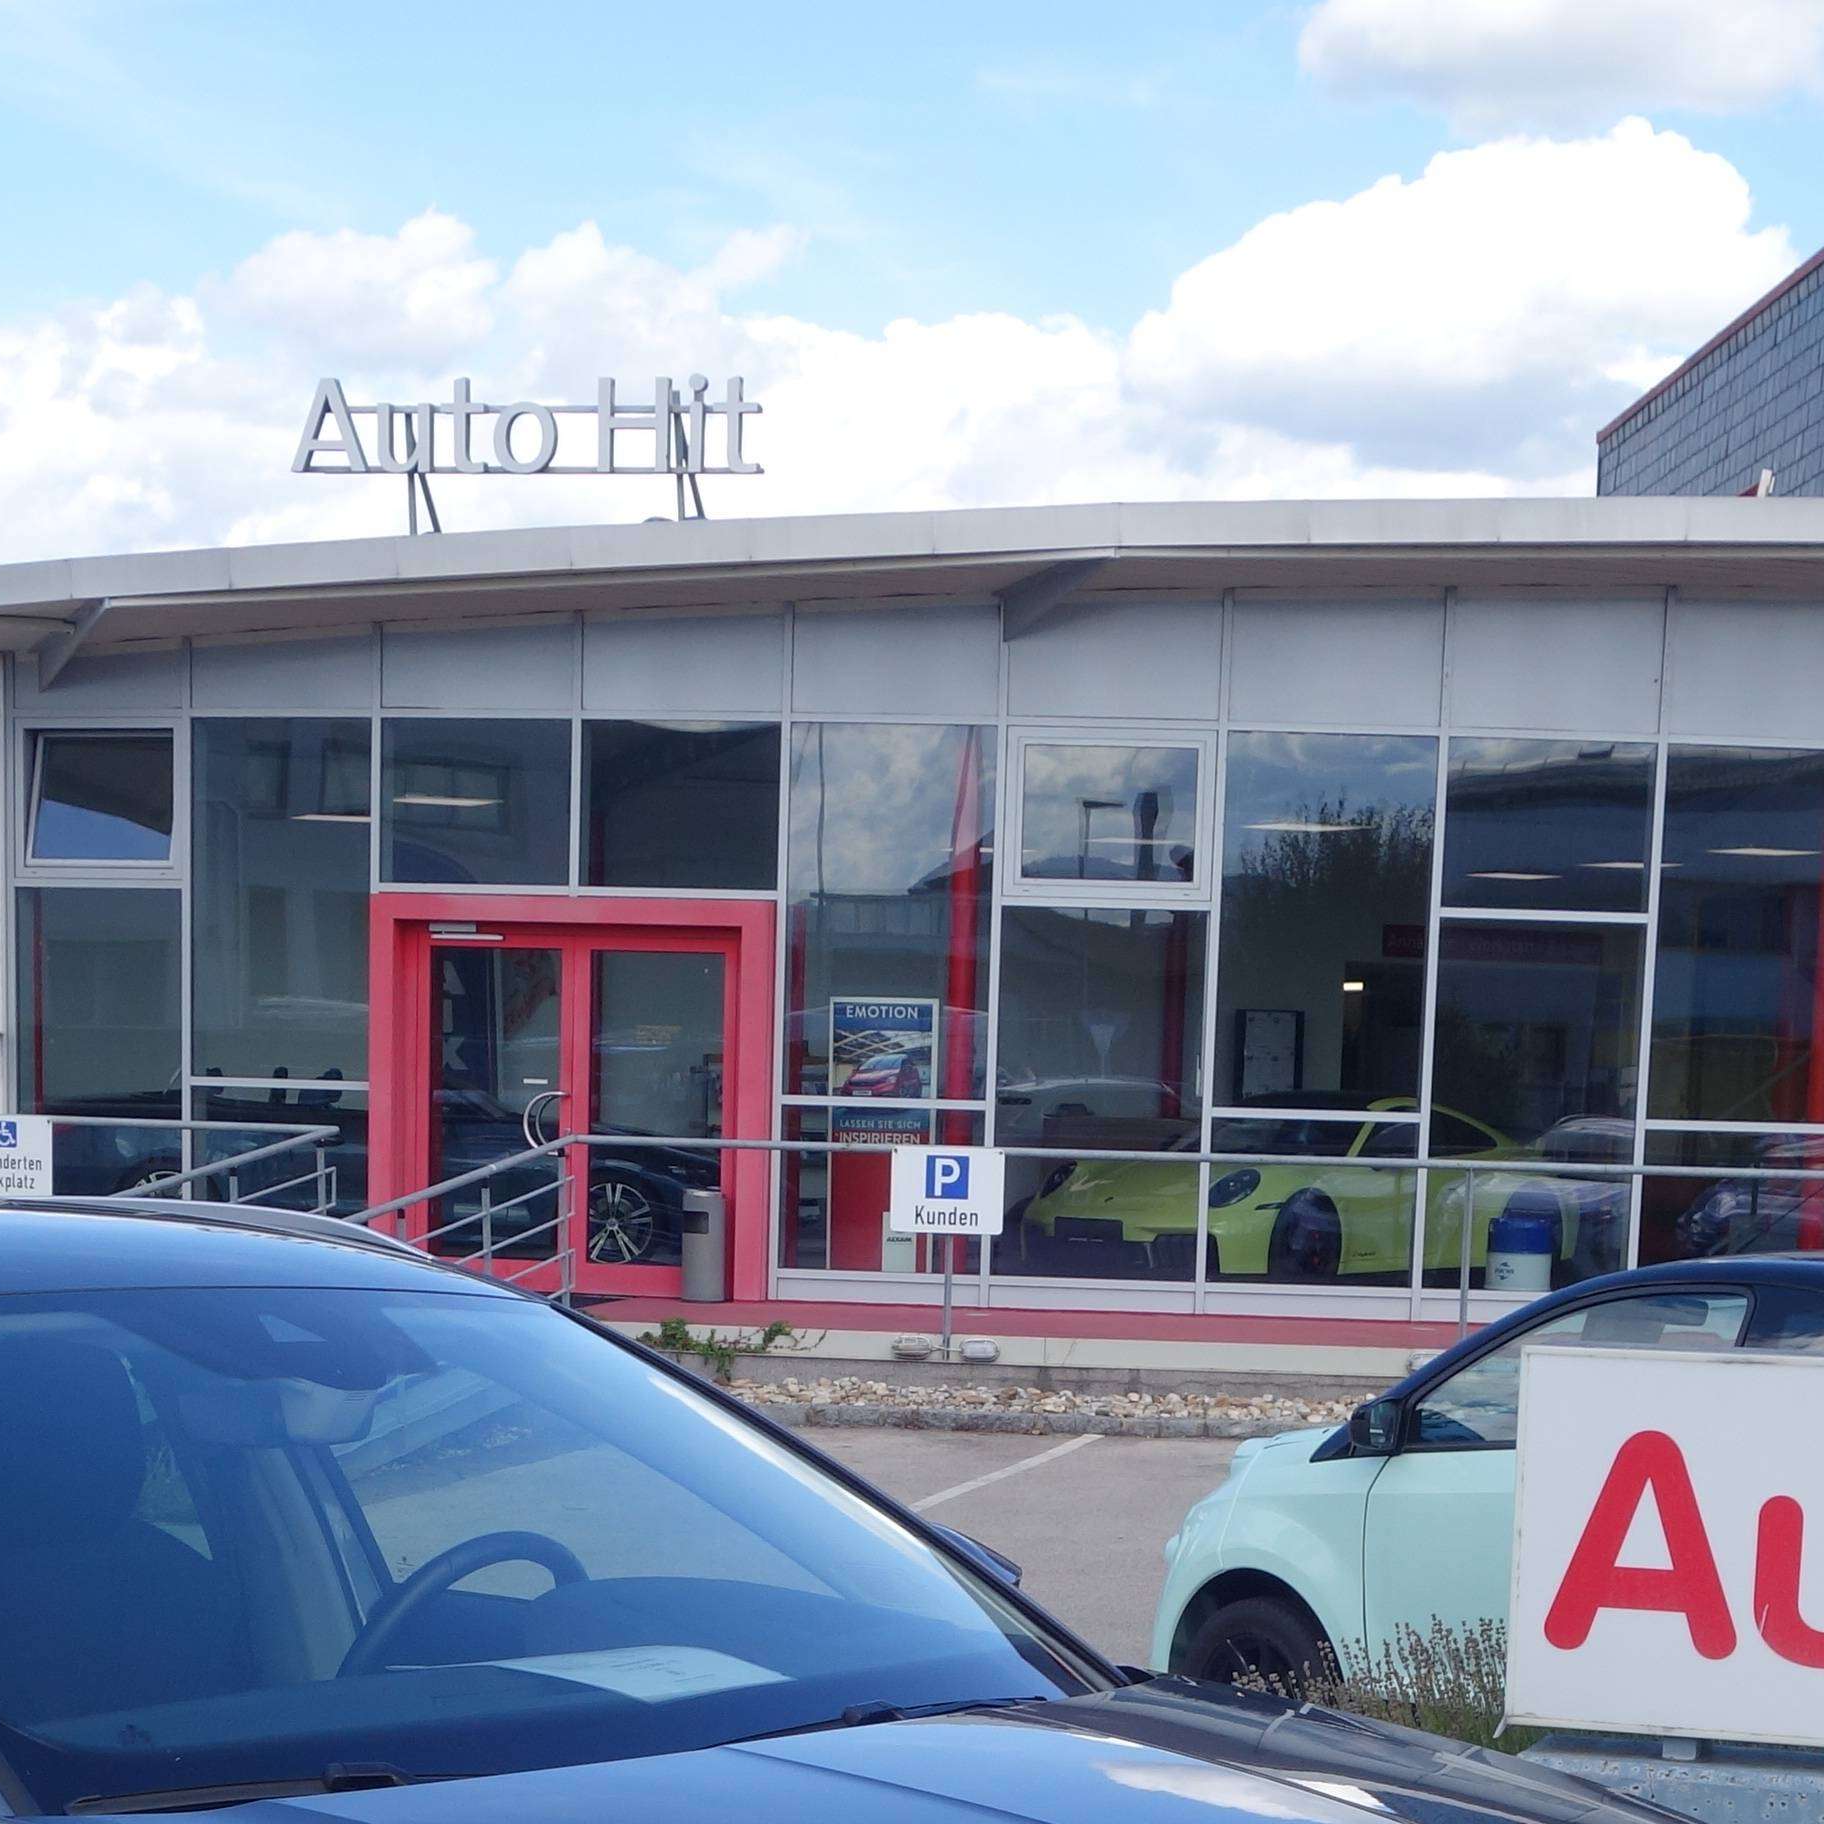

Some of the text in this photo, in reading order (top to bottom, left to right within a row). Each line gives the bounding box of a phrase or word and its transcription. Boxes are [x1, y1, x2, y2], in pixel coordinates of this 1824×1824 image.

[291, 373, 763, 474] Auto Hit
[846, 1005, 919, 1019] EMOTION
[839, 1119, 921, 1130] LASSEN SIE SICH
[839, 1131, 921, 1145] INSPIRIEREN
[934, 1158, 961, 1197] P
[914, 1205, 979, 1227] Kunden
